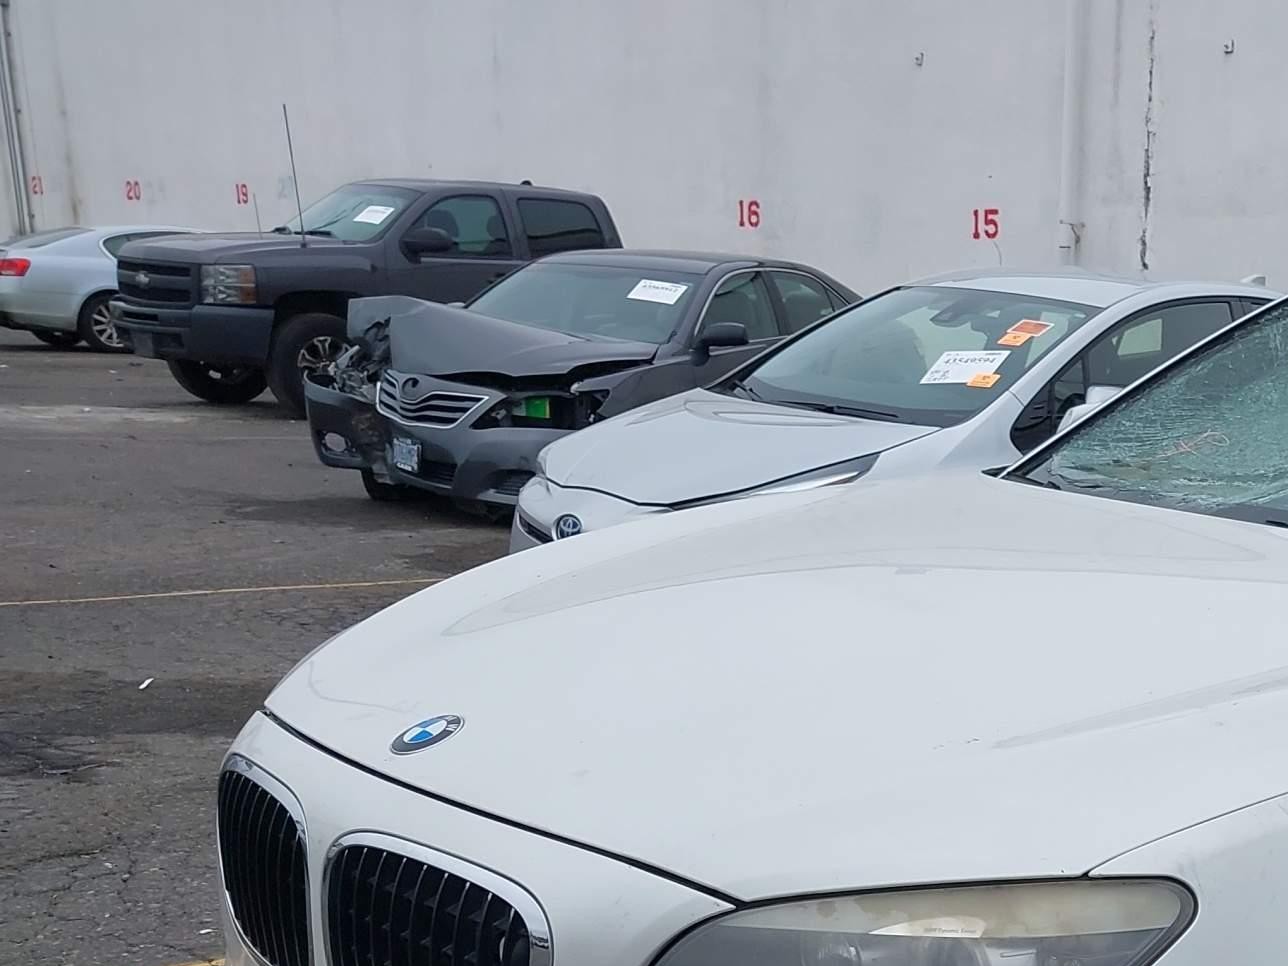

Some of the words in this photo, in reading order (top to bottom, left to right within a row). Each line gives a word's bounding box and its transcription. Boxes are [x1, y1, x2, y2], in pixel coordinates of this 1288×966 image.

[31, 176, 44, 195] 21
[125, 180, 142, 201] 20
[235, 183, 249, 204] 19
[738, 199, 761, 228] 16
[972, 208, 1000, 239] 15
